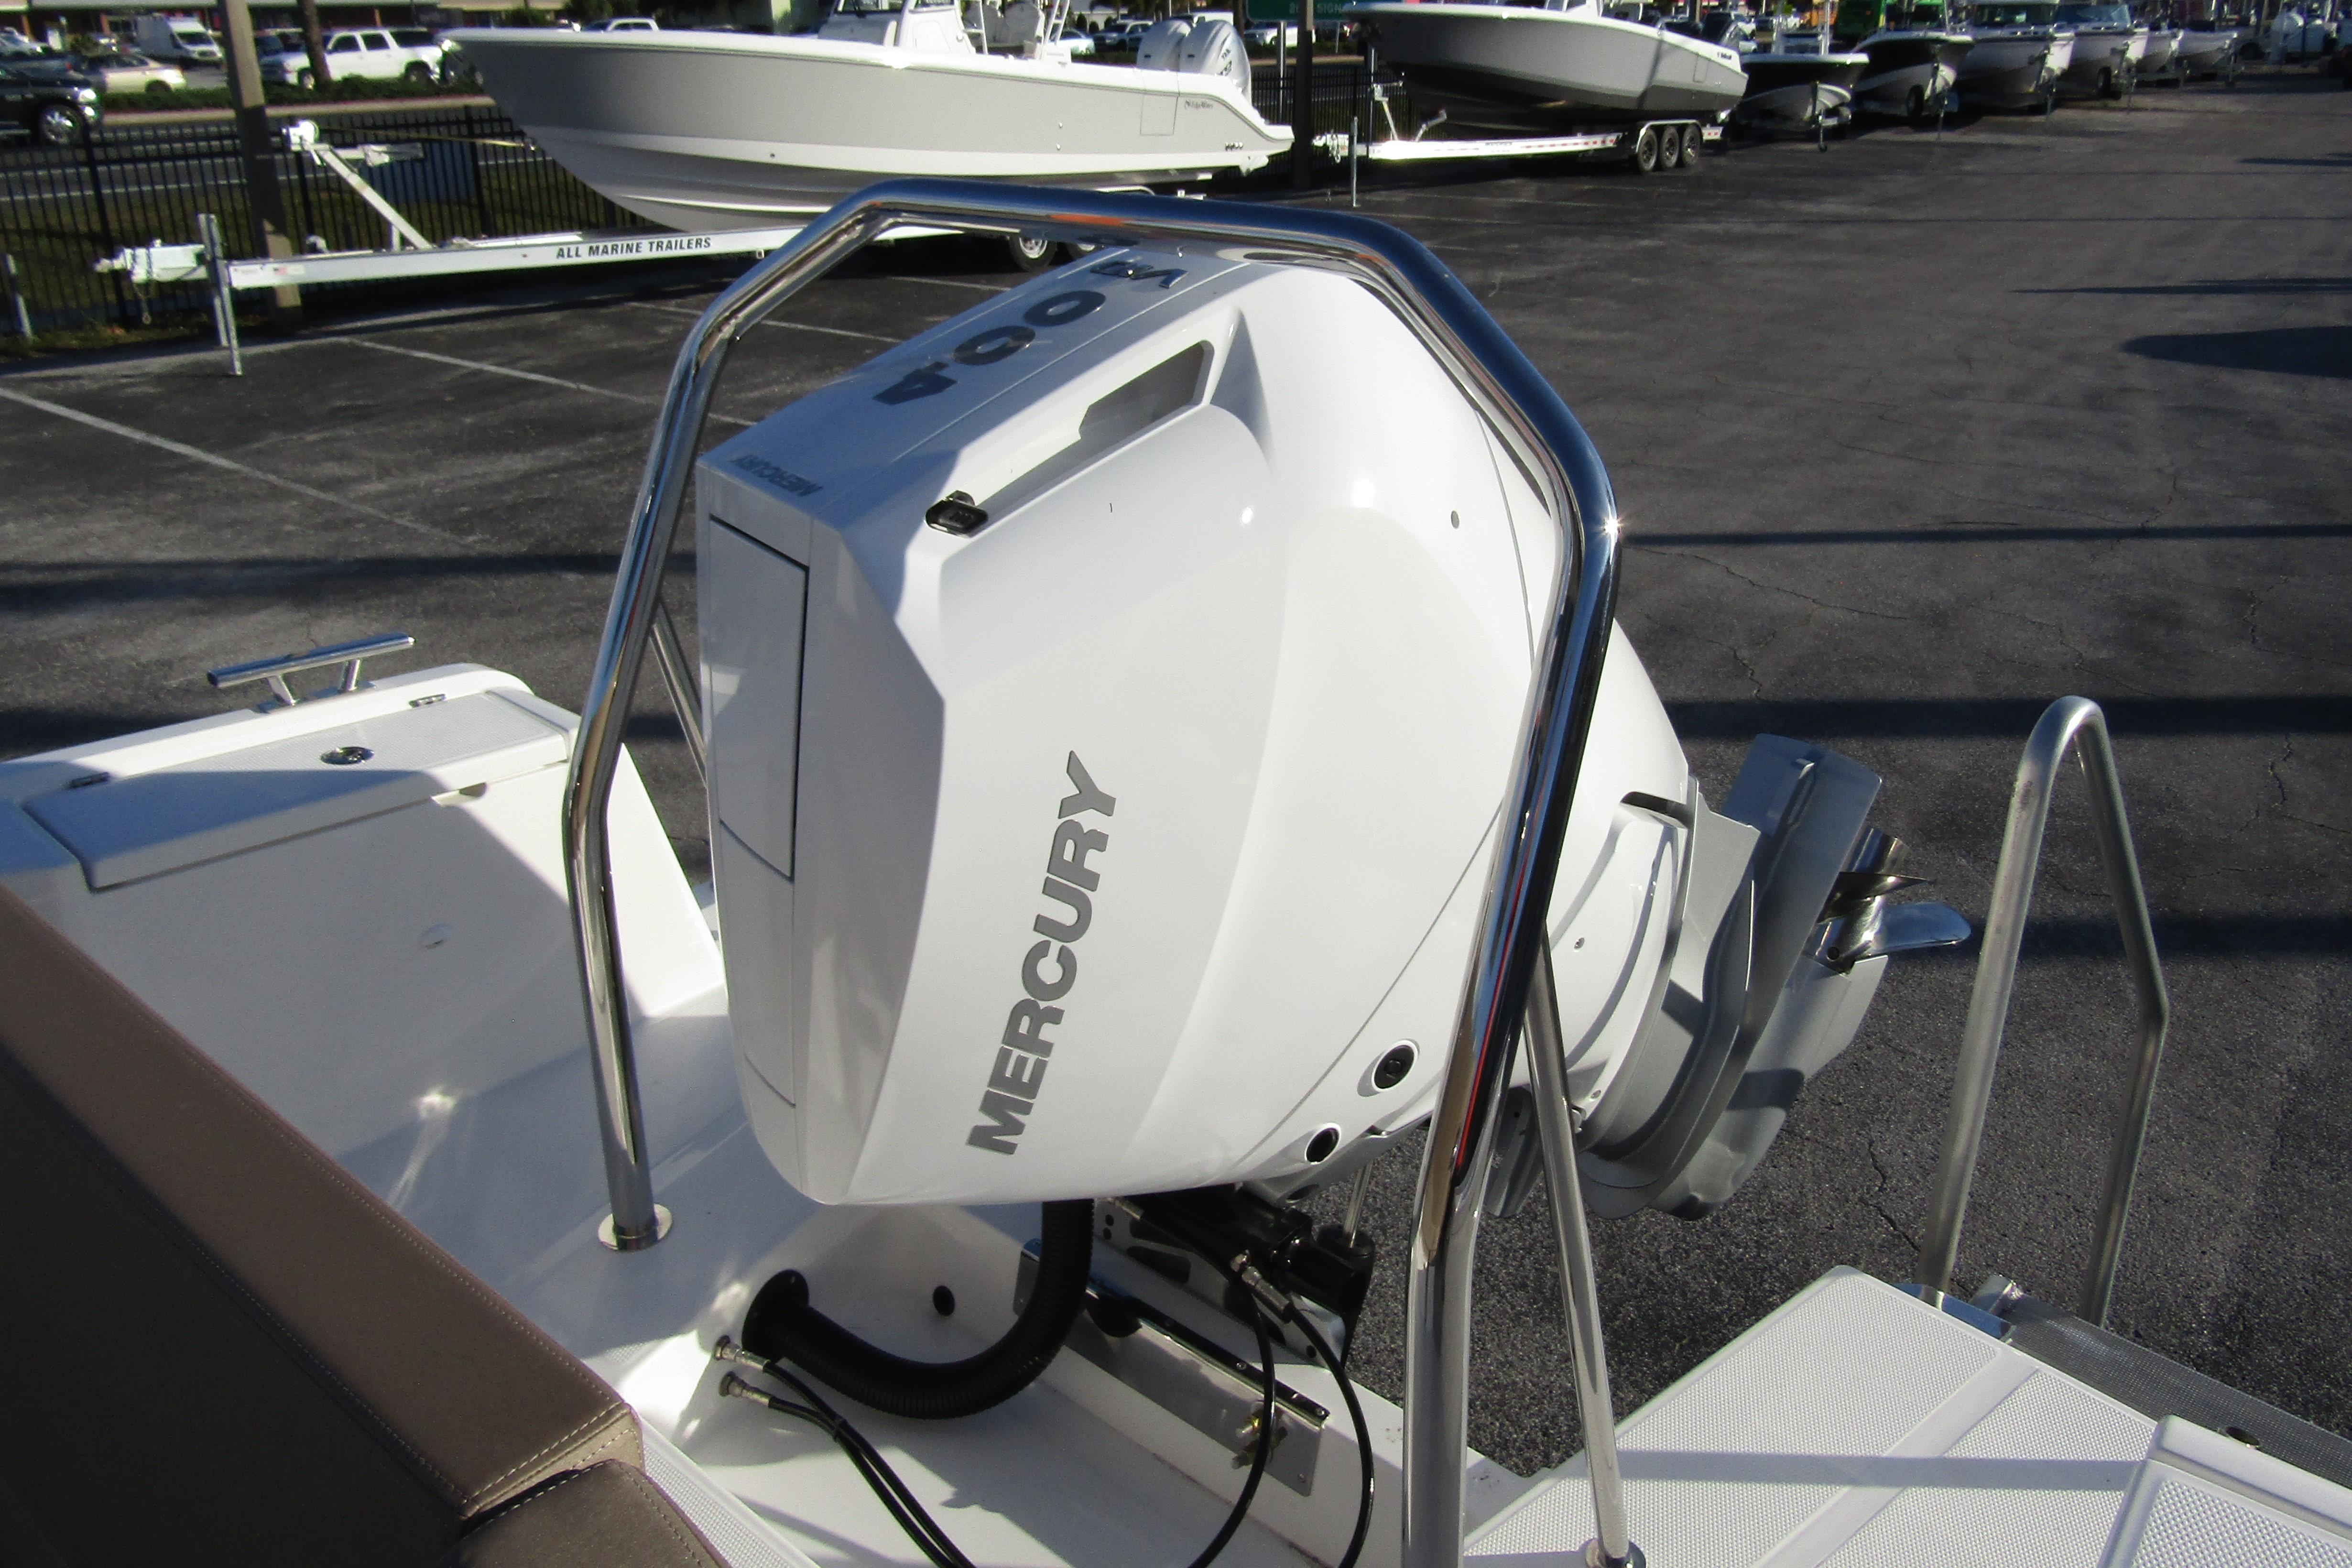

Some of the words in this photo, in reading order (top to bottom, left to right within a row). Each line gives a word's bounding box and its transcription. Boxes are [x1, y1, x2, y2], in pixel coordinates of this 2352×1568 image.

[556, 245, 582, 259] ALL
[588, 242, 642, 257] MARINE
[648, 237, 711, 252] TRAILERS
[872, 289, 1106, 406] 400
[730, 454, 823, 497] MERCURY
[966, 750, 1116, 1155] MERCURY
